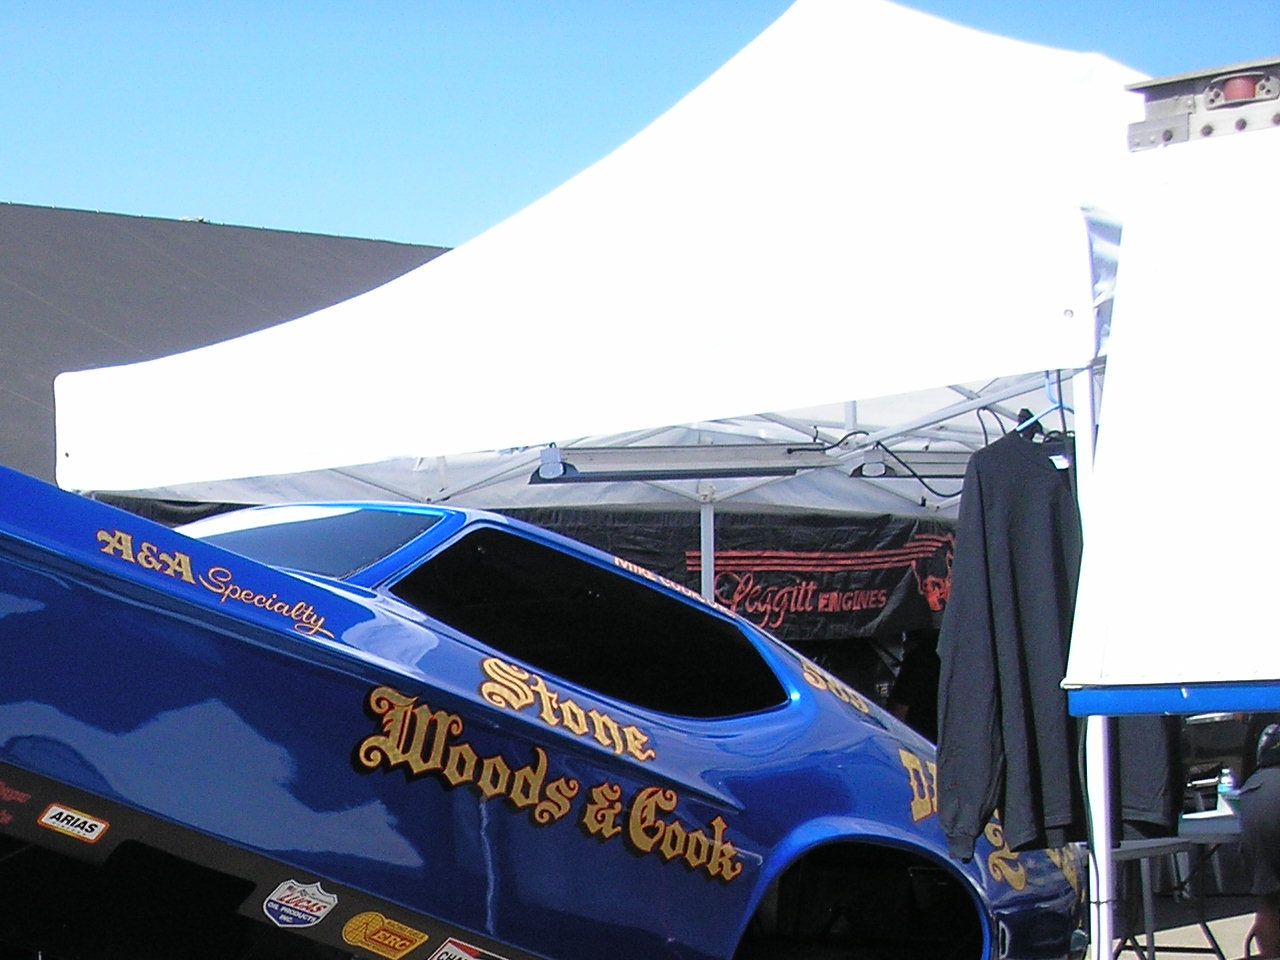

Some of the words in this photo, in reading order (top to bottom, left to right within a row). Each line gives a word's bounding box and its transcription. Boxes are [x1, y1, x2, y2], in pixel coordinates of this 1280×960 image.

[96, 529, 197, 586] A&A
[198, 567, 335, 639] Specialty
[714, 572, 817, 629] Leggitt
[818, 589, 888, 613] ENGINES
[481, 657, 656, 762] Stone
[49, 811, 99, 834] ARIAS
[358, 686, 579, 825] Woods
[583, 782, 622, 839] &
[629, 786, 743, 882] Cook
[278, 906, 318, 924] PRODUCTS
